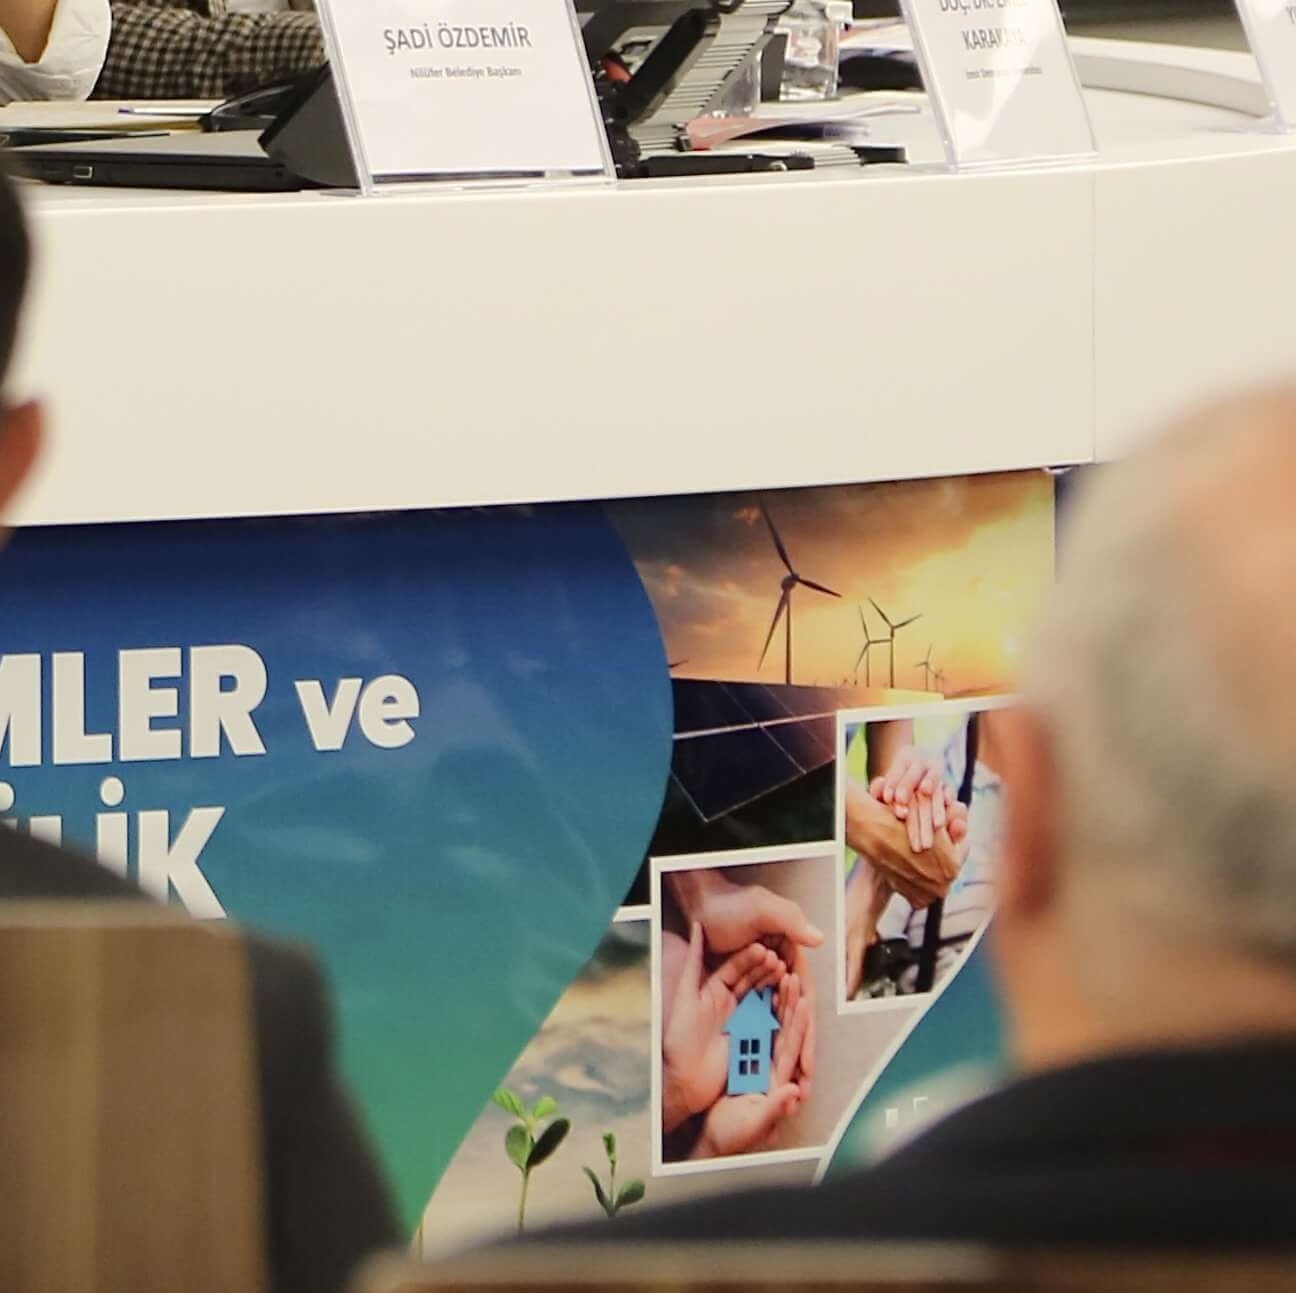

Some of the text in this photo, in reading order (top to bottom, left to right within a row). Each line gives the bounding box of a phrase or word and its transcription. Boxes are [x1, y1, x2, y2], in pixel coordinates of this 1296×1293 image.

[383, 21, 532, 56] ŞADİ ÖZDEMİR
[294, 673, 420, 752] ve
